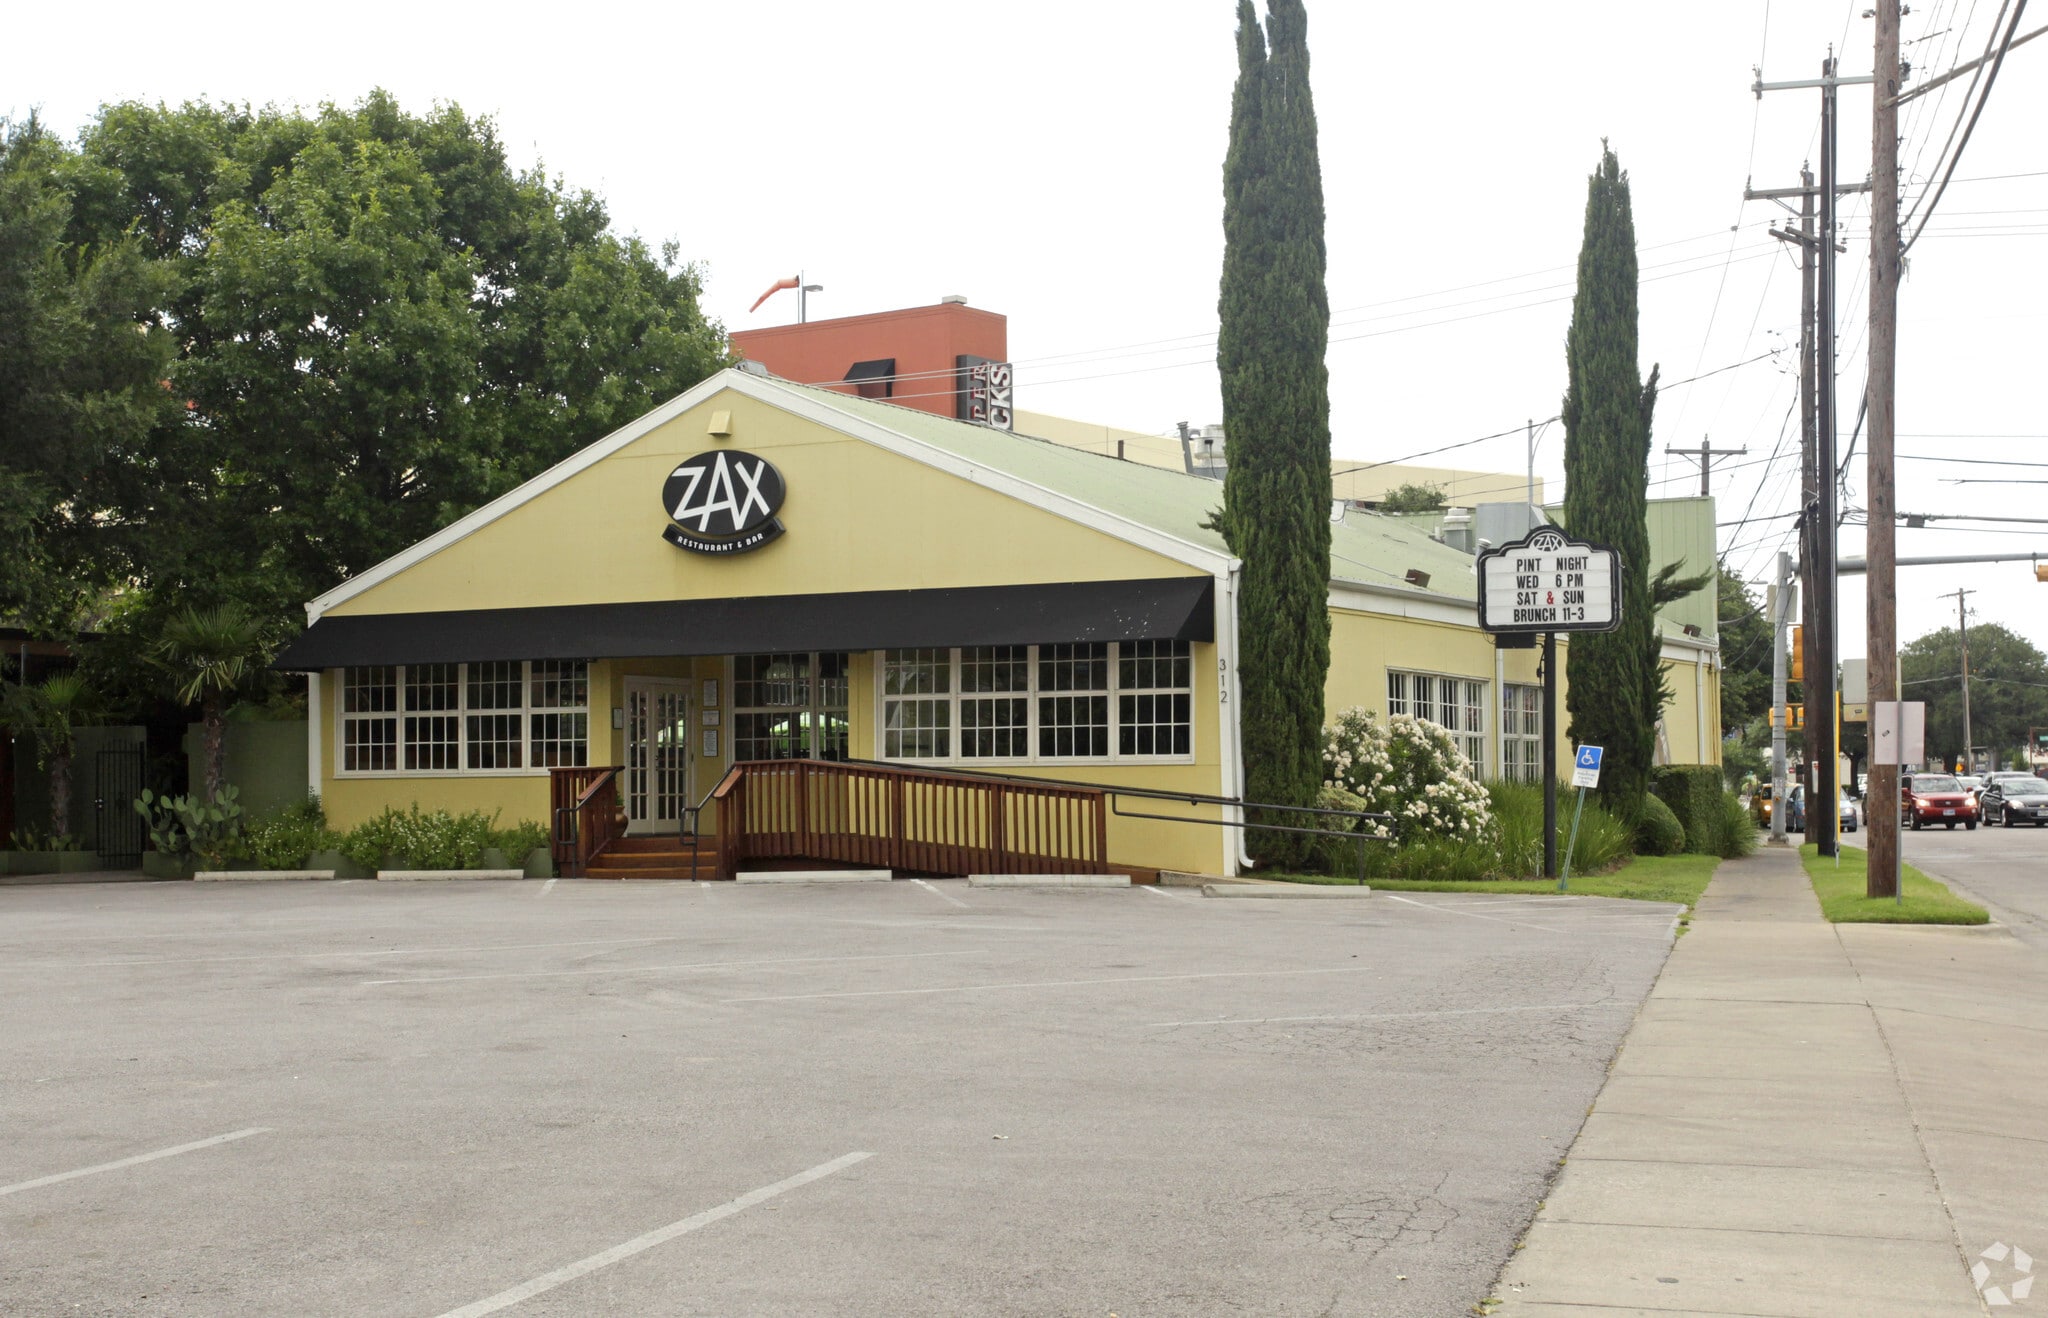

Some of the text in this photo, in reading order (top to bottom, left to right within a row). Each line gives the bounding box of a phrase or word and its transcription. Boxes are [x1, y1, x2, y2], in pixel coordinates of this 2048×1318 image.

[671, 451, 771, 532] ZAX
[677, 535, 733, 551] RESTAURANT
[746, 533, 764, 546] BAR
[1533, 533, 1562, 552] ZAX
[1516, 556, 1589, 572] PINT NIGHT
[1516, 574, 1584, 589] WED 6 PM
[1517, 590, 1584, 605] SAT & SUN
[1513, 607, 1585, 623] BRUNCH 11-3
[1219, 658, 1228, 703] 312
